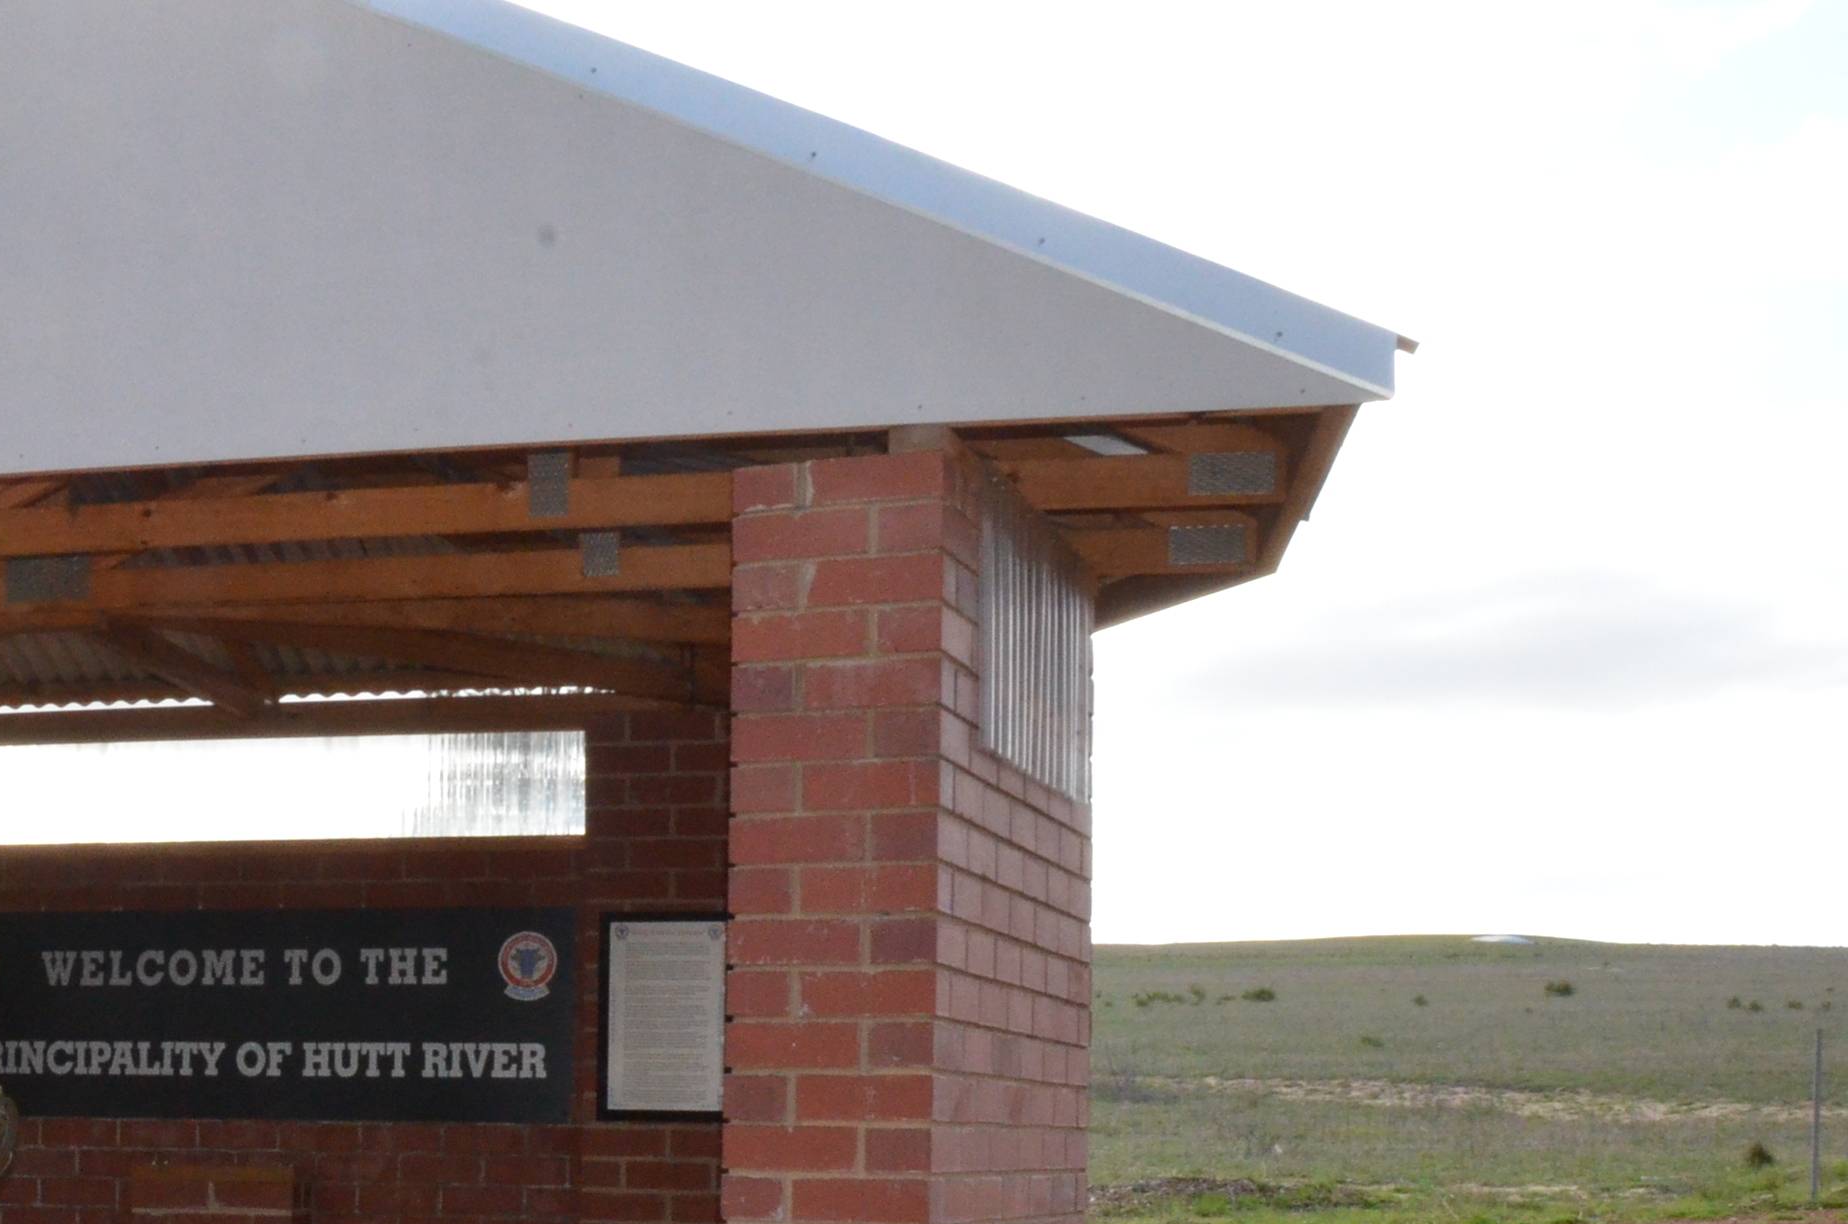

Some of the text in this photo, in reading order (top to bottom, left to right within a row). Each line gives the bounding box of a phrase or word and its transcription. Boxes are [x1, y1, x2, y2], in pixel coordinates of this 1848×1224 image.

[42, 947, 447, 986] WELCOME TO THE
[235, 1041, 292, 1077] OF
[302, 1042, 411, 1077] HUTT
[421, 1042, 547, 1079] RIVER
